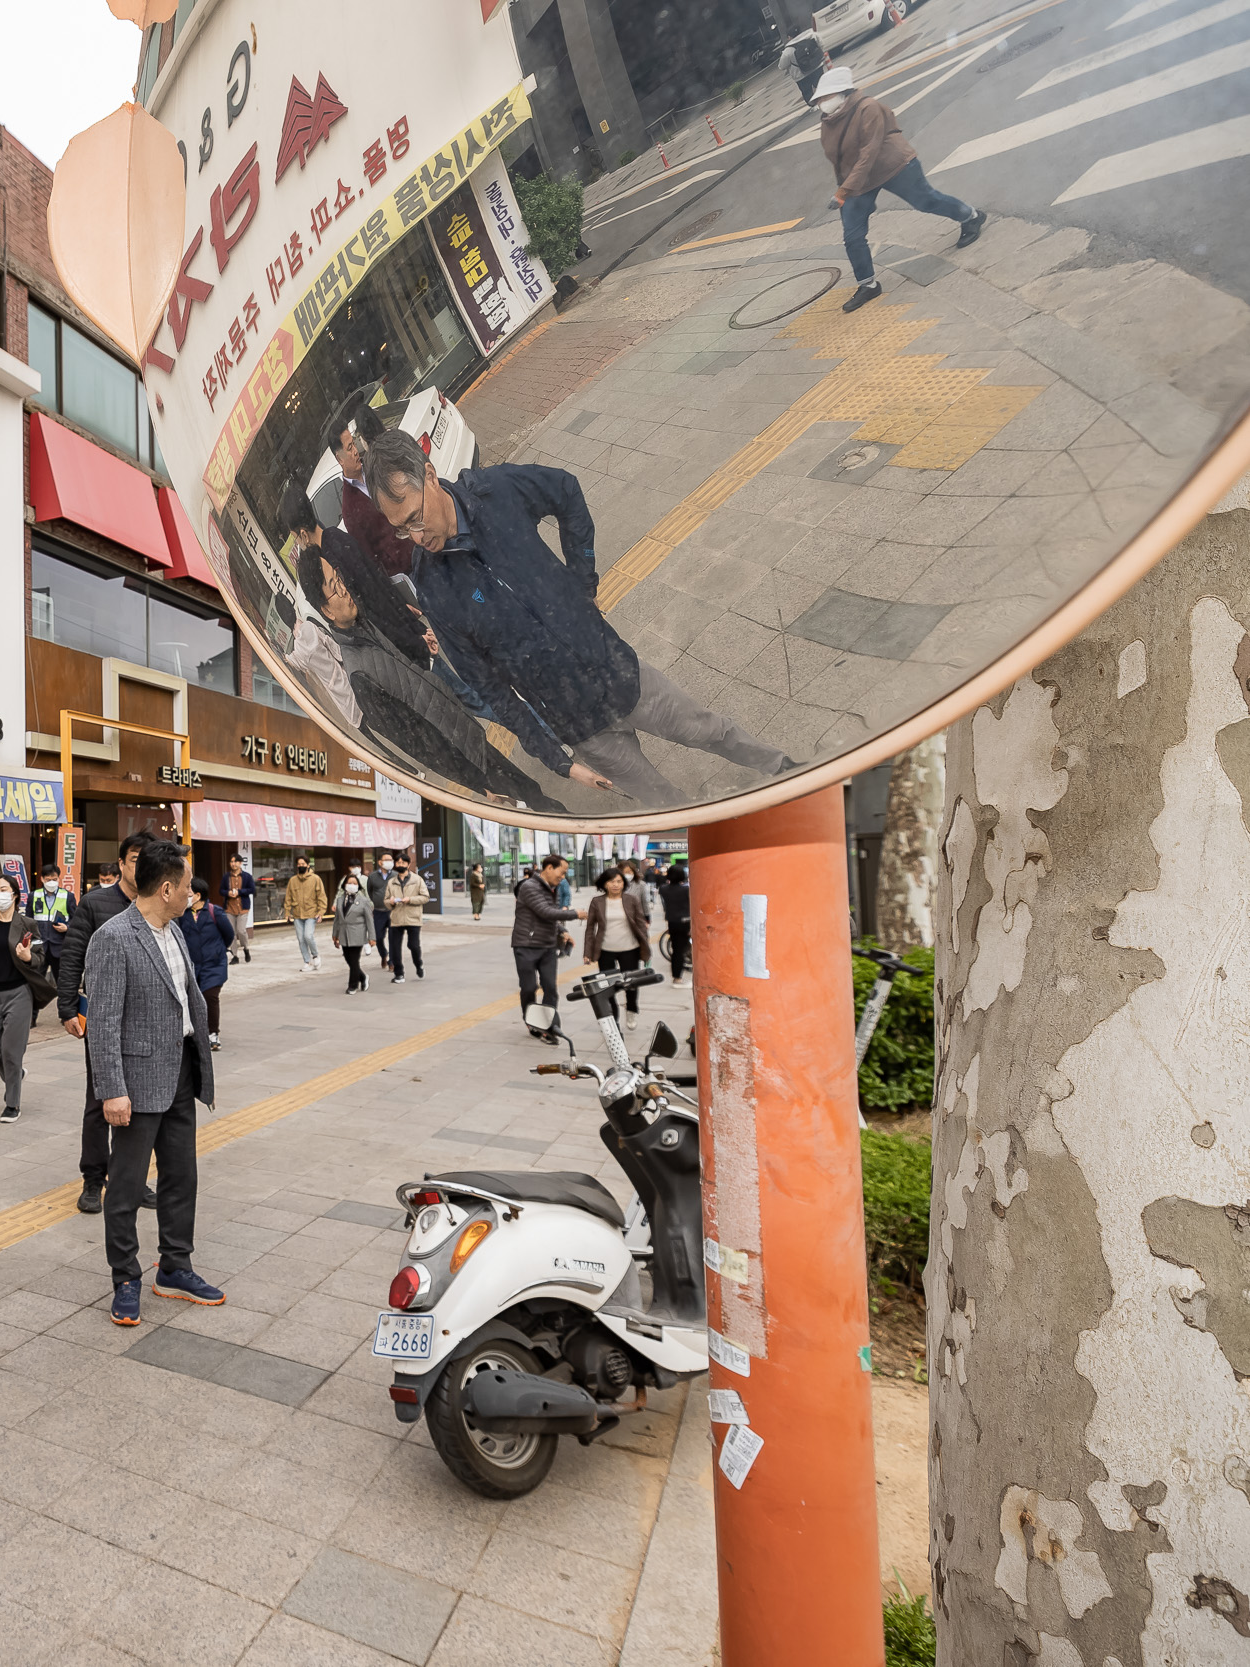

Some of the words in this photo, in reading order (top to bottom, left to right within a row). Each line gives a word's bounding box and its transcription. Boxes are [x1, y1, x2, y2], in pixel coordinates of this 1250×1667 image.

[243, 734, 269, 765] 가구
[273, 742, 283, 766] &
[287, 743, 328, 777] 인테리어
[161, 765, 203, 788] 트라바스
[334, 820, 376, 846] 전문점
[391, 1332, 428, 1353] 2668
